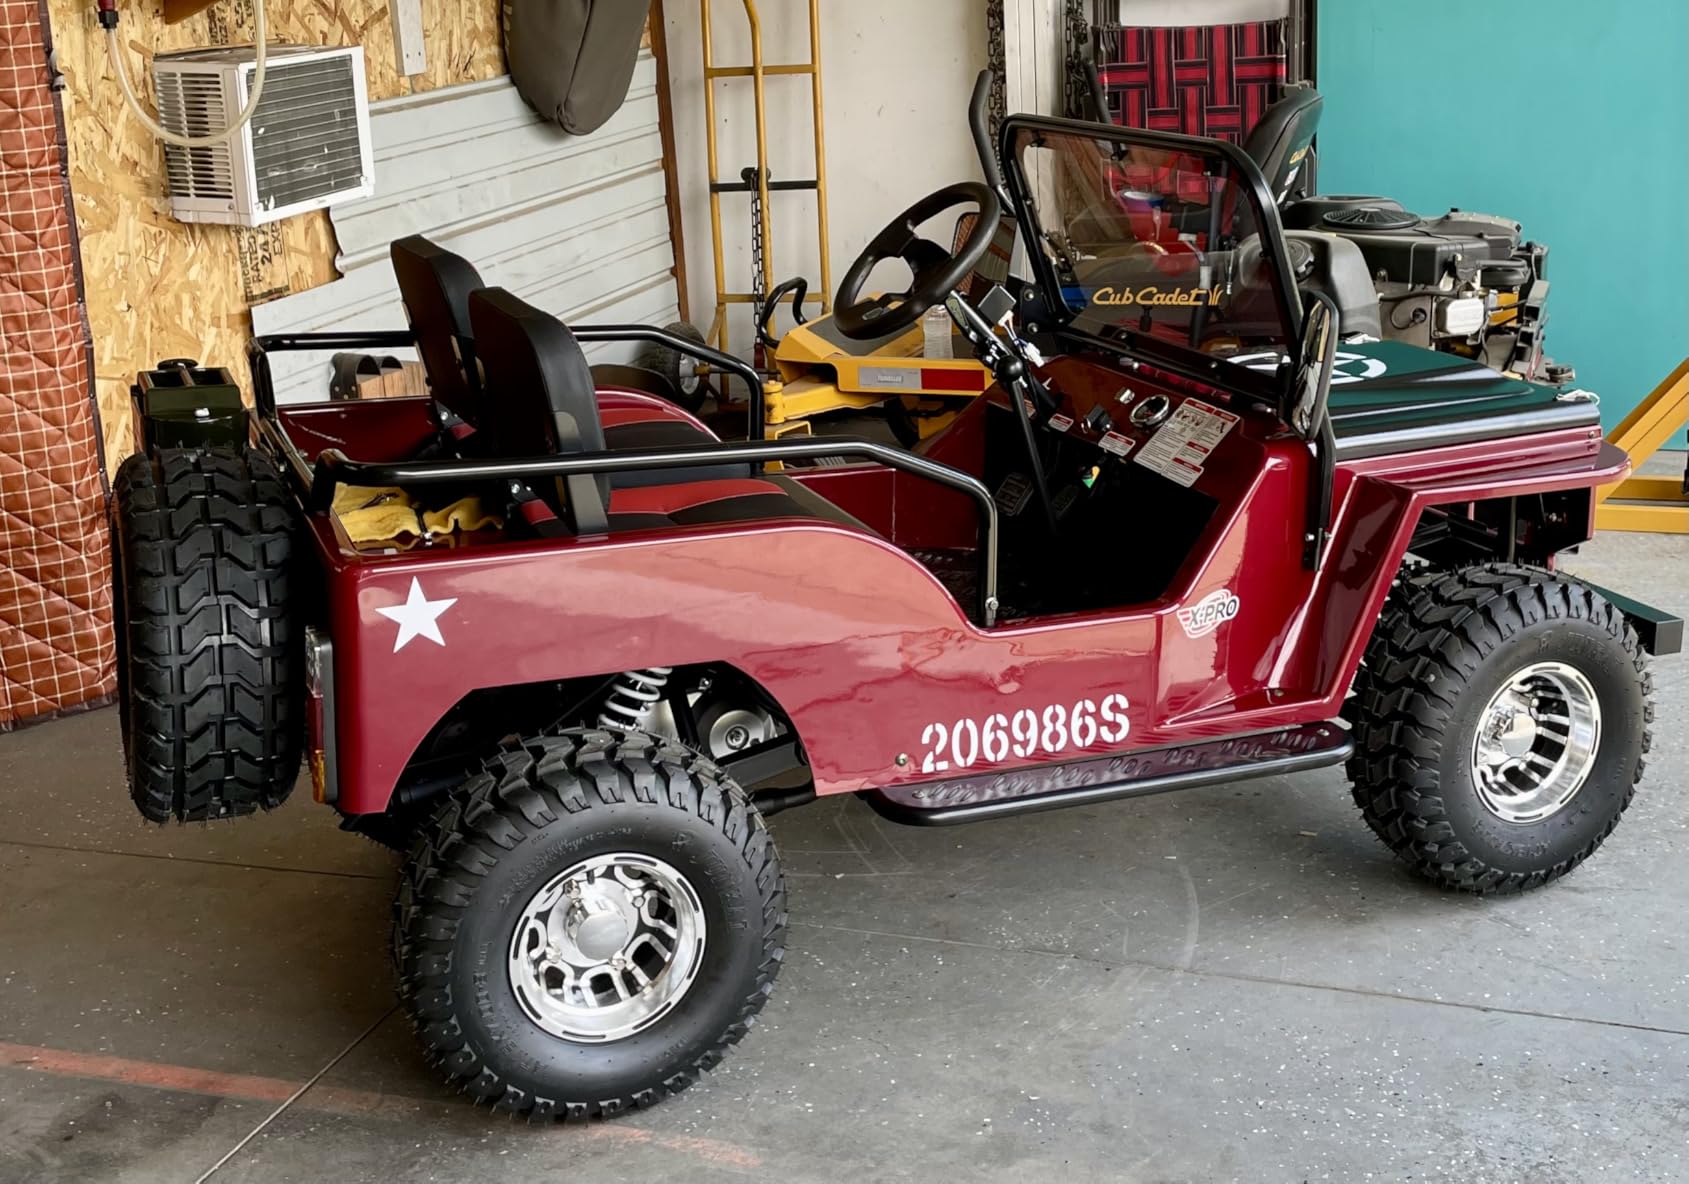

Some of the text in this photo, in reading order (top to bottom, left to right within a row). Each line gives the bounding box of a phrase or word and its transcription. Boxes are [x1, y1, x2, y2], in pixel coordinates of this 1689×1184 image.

[1092, 286, 1206, 306] Cub Cadet
[921, 693, 1131, 774] 206986S
